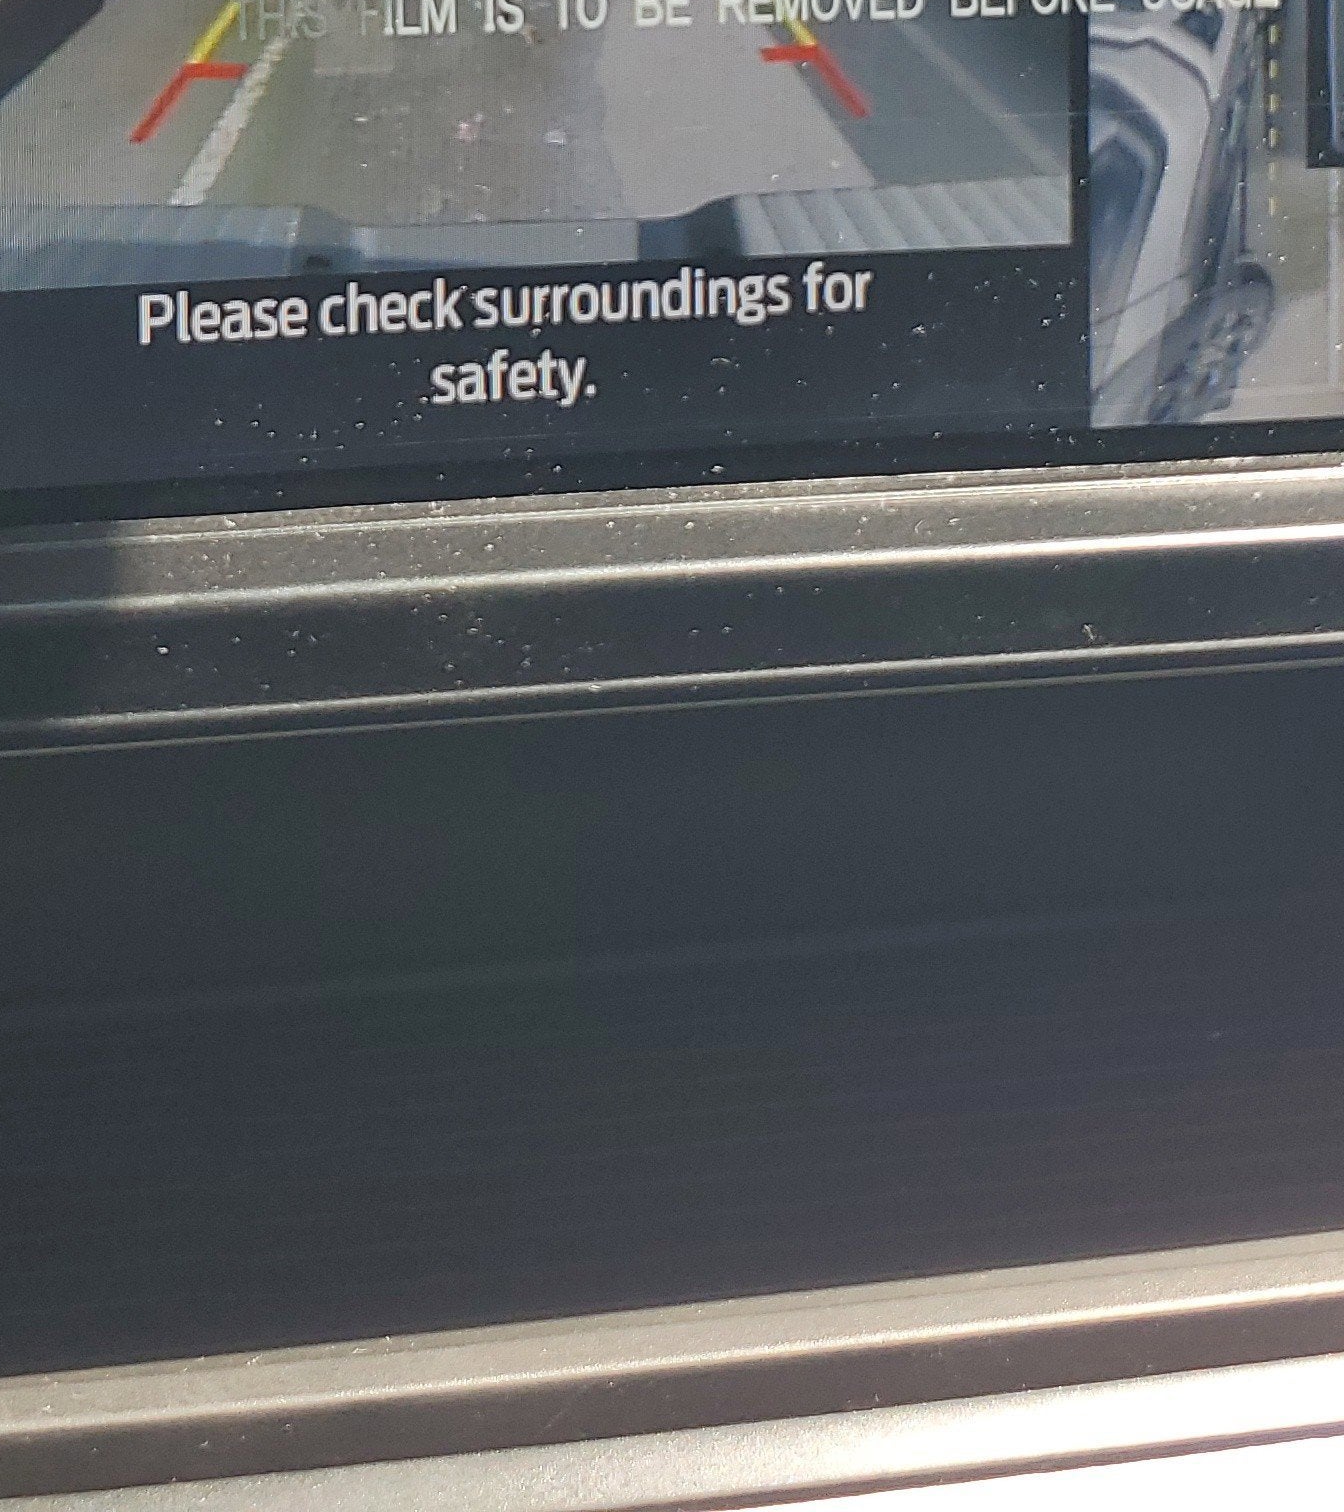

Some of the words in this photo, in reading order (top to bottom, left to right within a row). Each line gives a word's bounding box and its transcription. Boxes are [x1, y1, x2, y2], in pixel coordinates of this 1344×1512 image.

[138, 289, 308, 345] Please
[318, 276, 464, 334] check
[475, 266, 790, 327] surroundings
[801, 261, 873, 313] for
[429, 348, 597, 407] safety.
